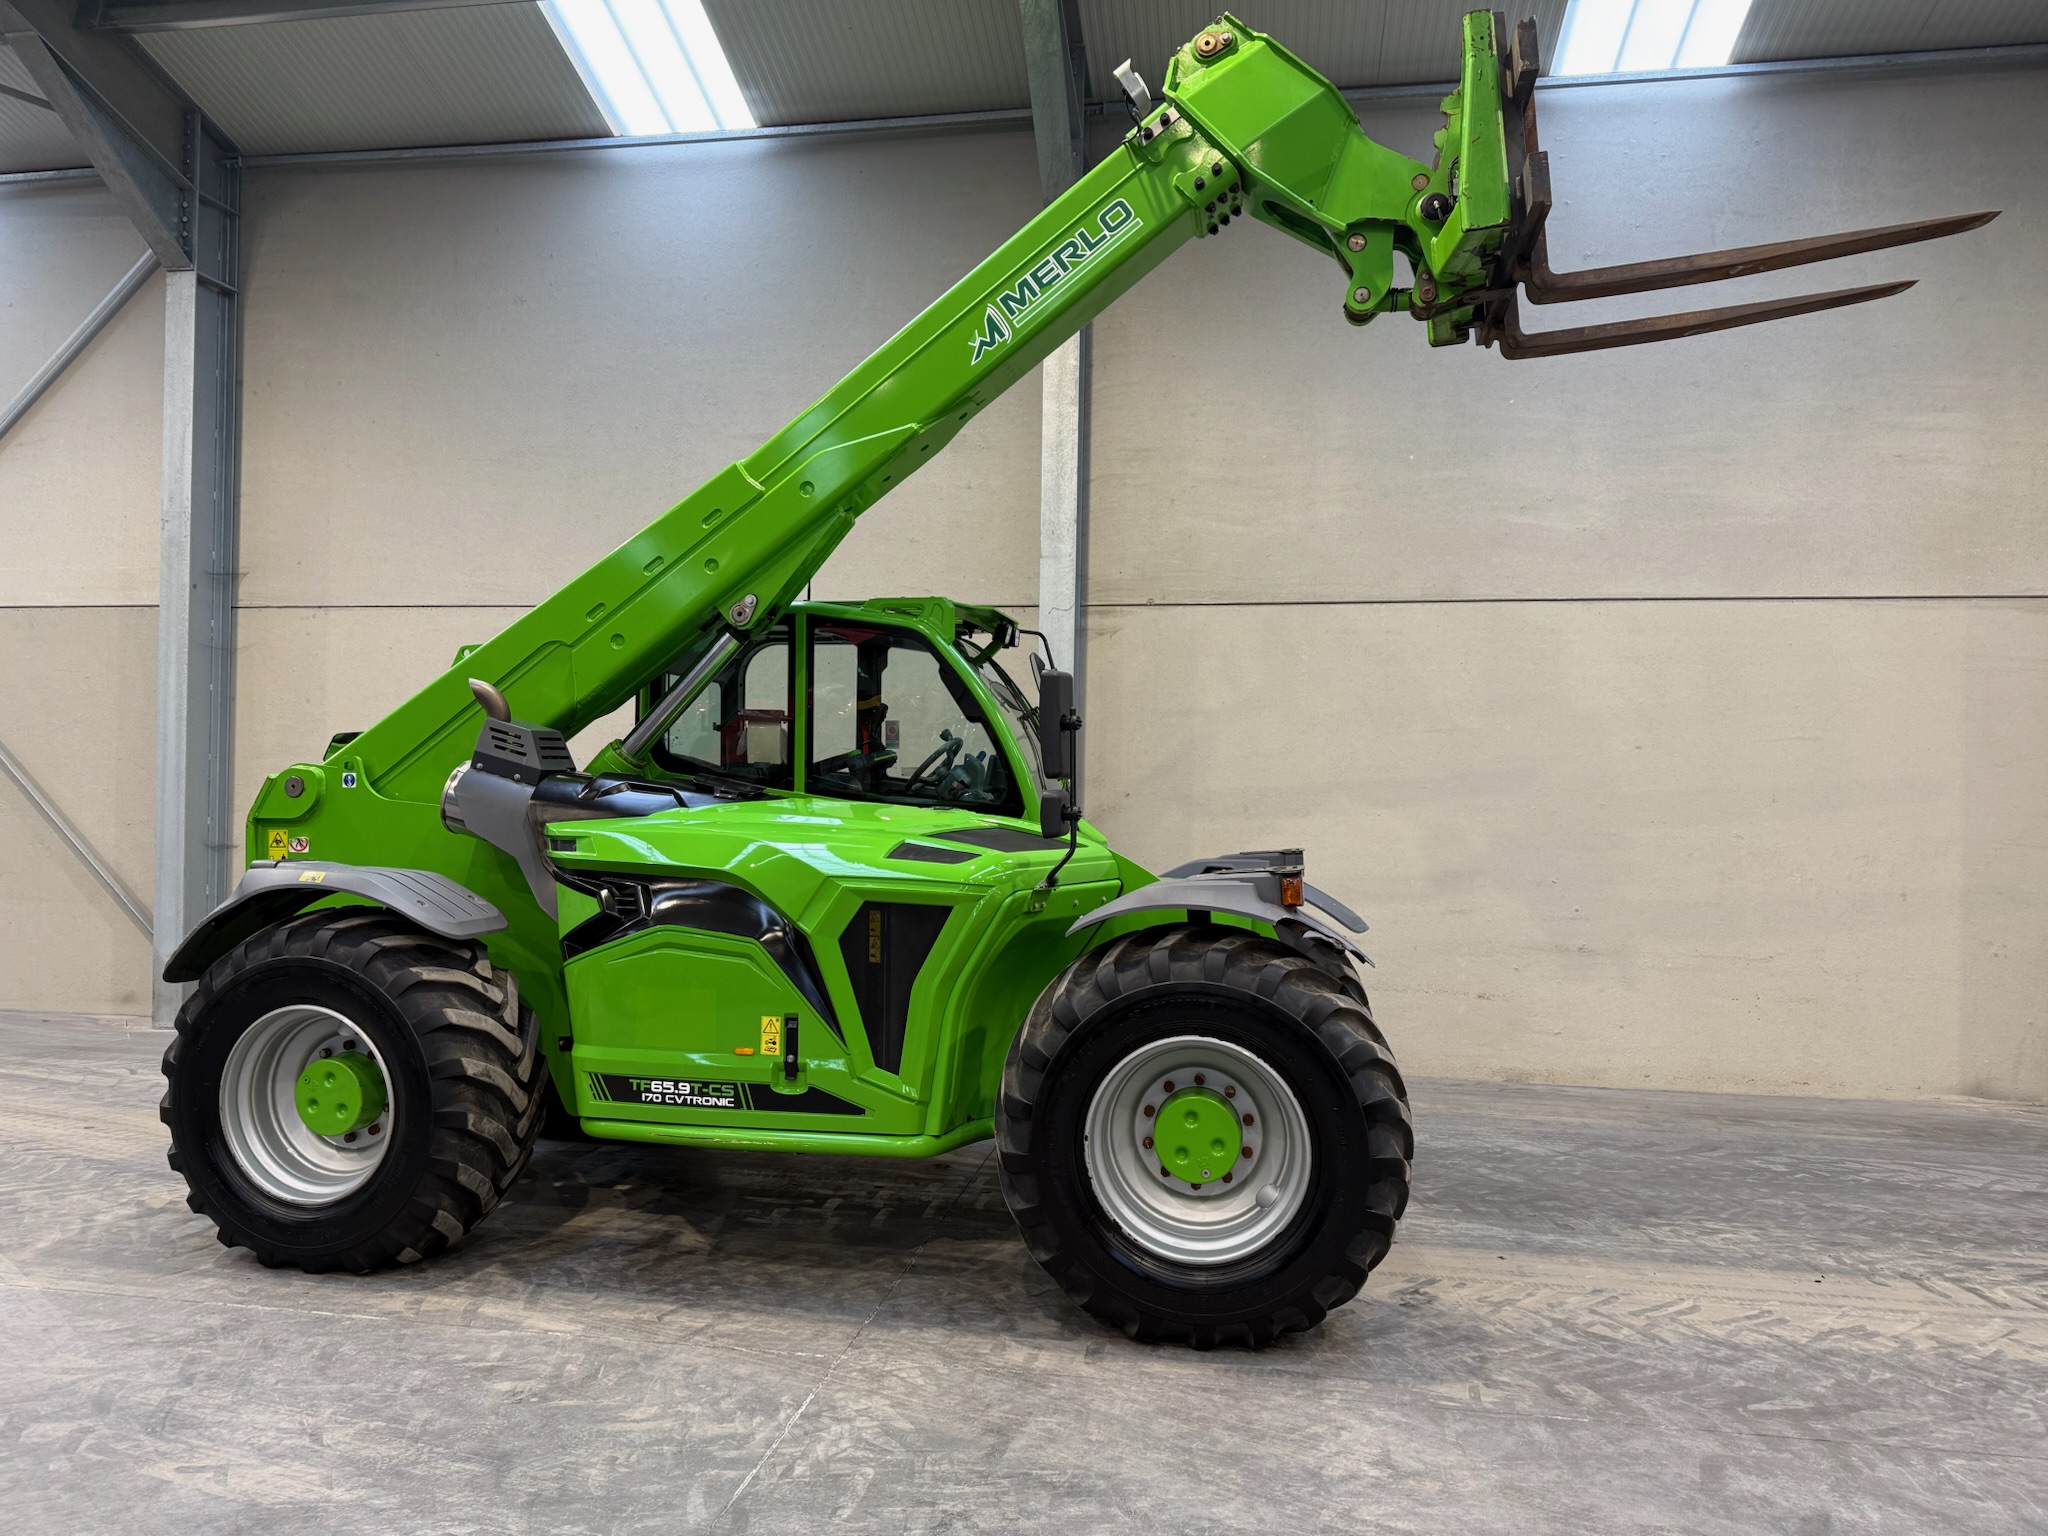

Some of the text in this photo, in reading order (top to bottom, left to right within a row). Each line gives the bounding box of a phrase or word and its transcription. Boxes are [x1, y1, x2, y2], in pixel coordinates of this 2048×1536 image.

[996, 197, 1135, 320] MERLO
[629, 1079, 735, 1097] TF65.9T-CS
[641, 1092, 735, 1107] 170 CVTRONIC
